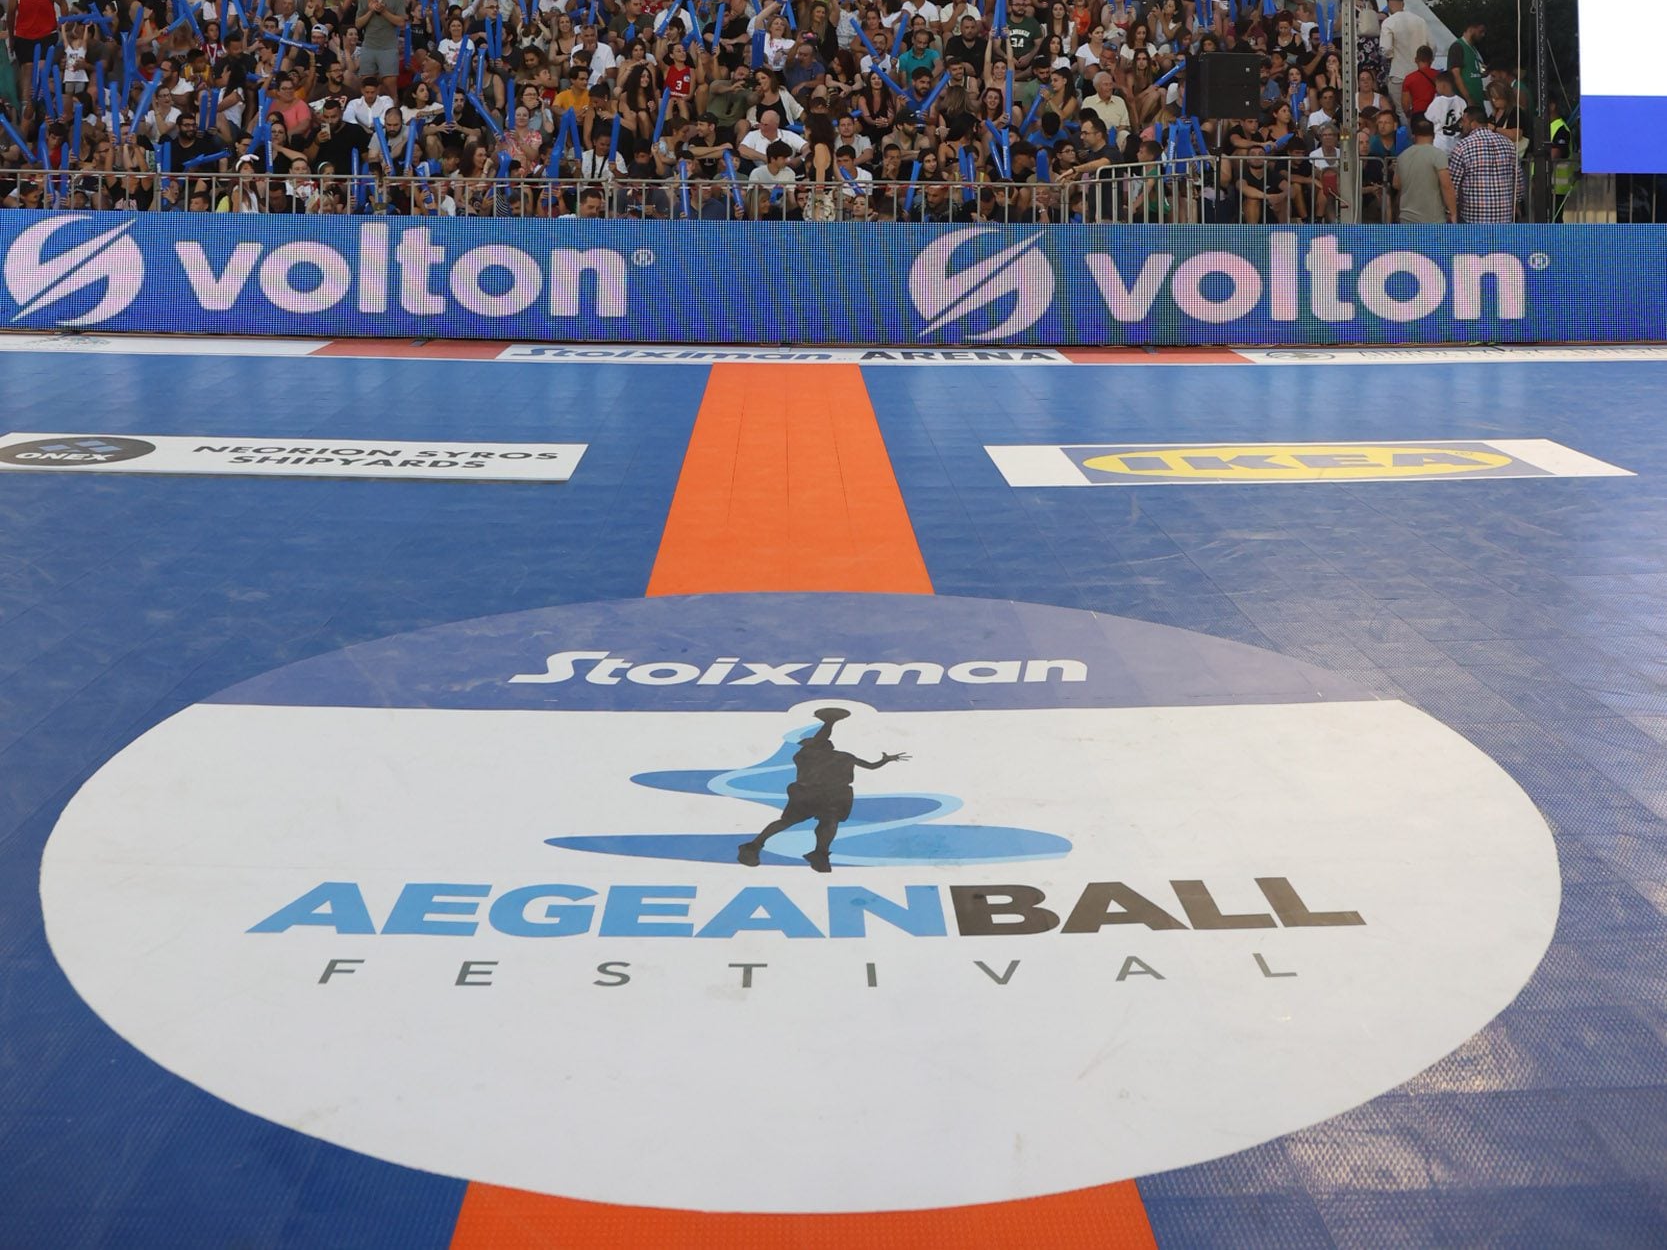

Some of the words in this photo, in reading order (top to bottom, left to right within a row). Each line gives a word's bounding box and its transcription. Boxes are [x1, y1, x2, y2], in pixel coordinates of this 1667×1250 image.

[675, 80, 683, 91] 3
[511, 348, 832, 361] Stoiximan
[859, 350, 1058, 361] ARENA
[15, 452, 116, 462] ONEX
[193, 445, 401, 458] NEORION
[414, 450, 560, 461] SYROS
[228, 455, 488, 469] SHIPYARDS
[1117, 453, 1490, 472] IKEA
[508, 651, 1088, 685] Stoiximan
[317, 953, 1297, 988] FESTIVAL
